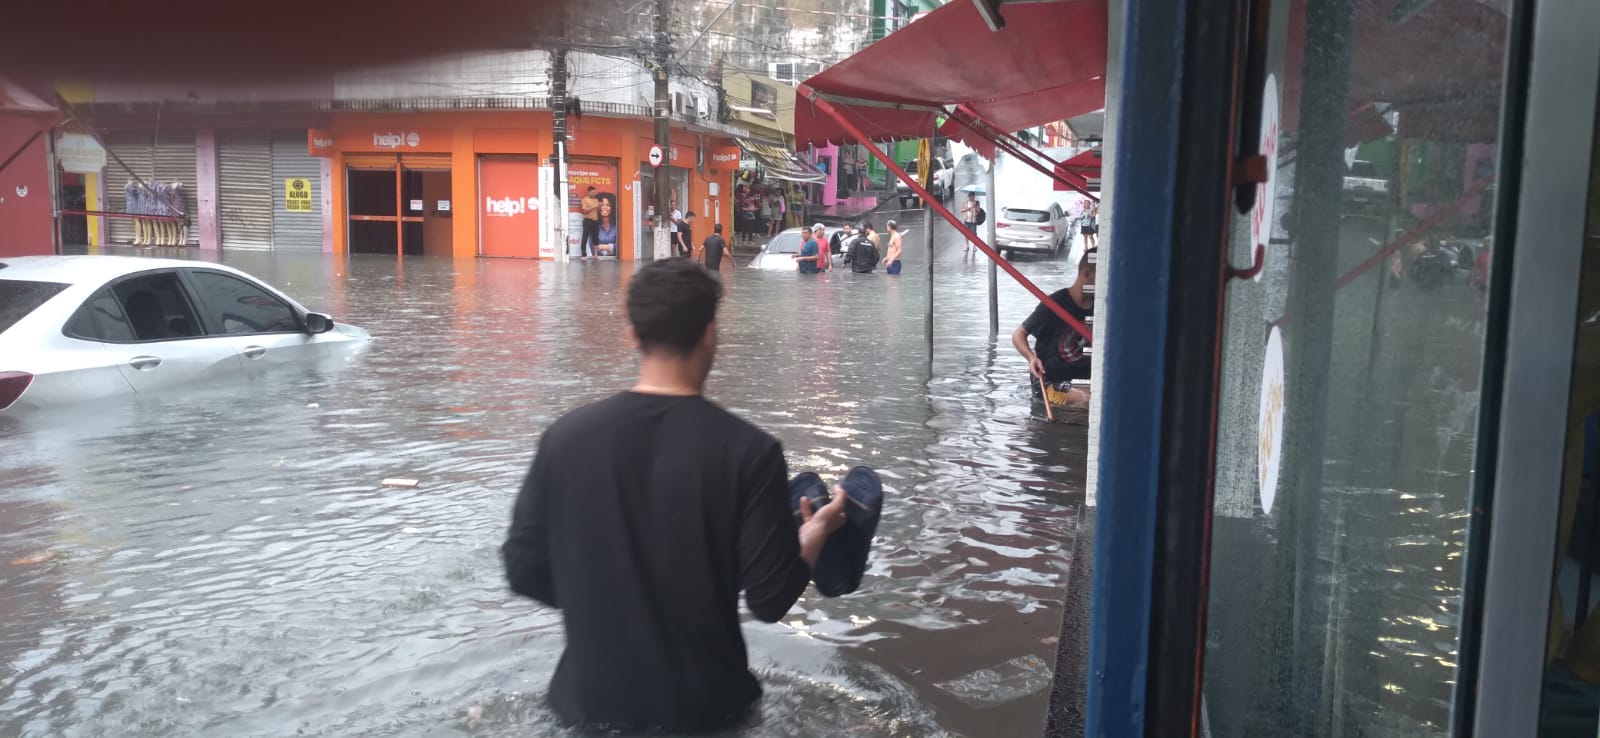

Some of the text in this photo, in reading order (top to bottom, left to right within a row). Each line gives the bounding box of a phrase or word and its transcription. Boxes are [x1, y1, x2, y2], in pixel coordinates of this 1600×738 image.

[373, 131, 405, 149] help!
[289, 191, 308, 199] ALUGO
[486, 196, 525, 217] help!
